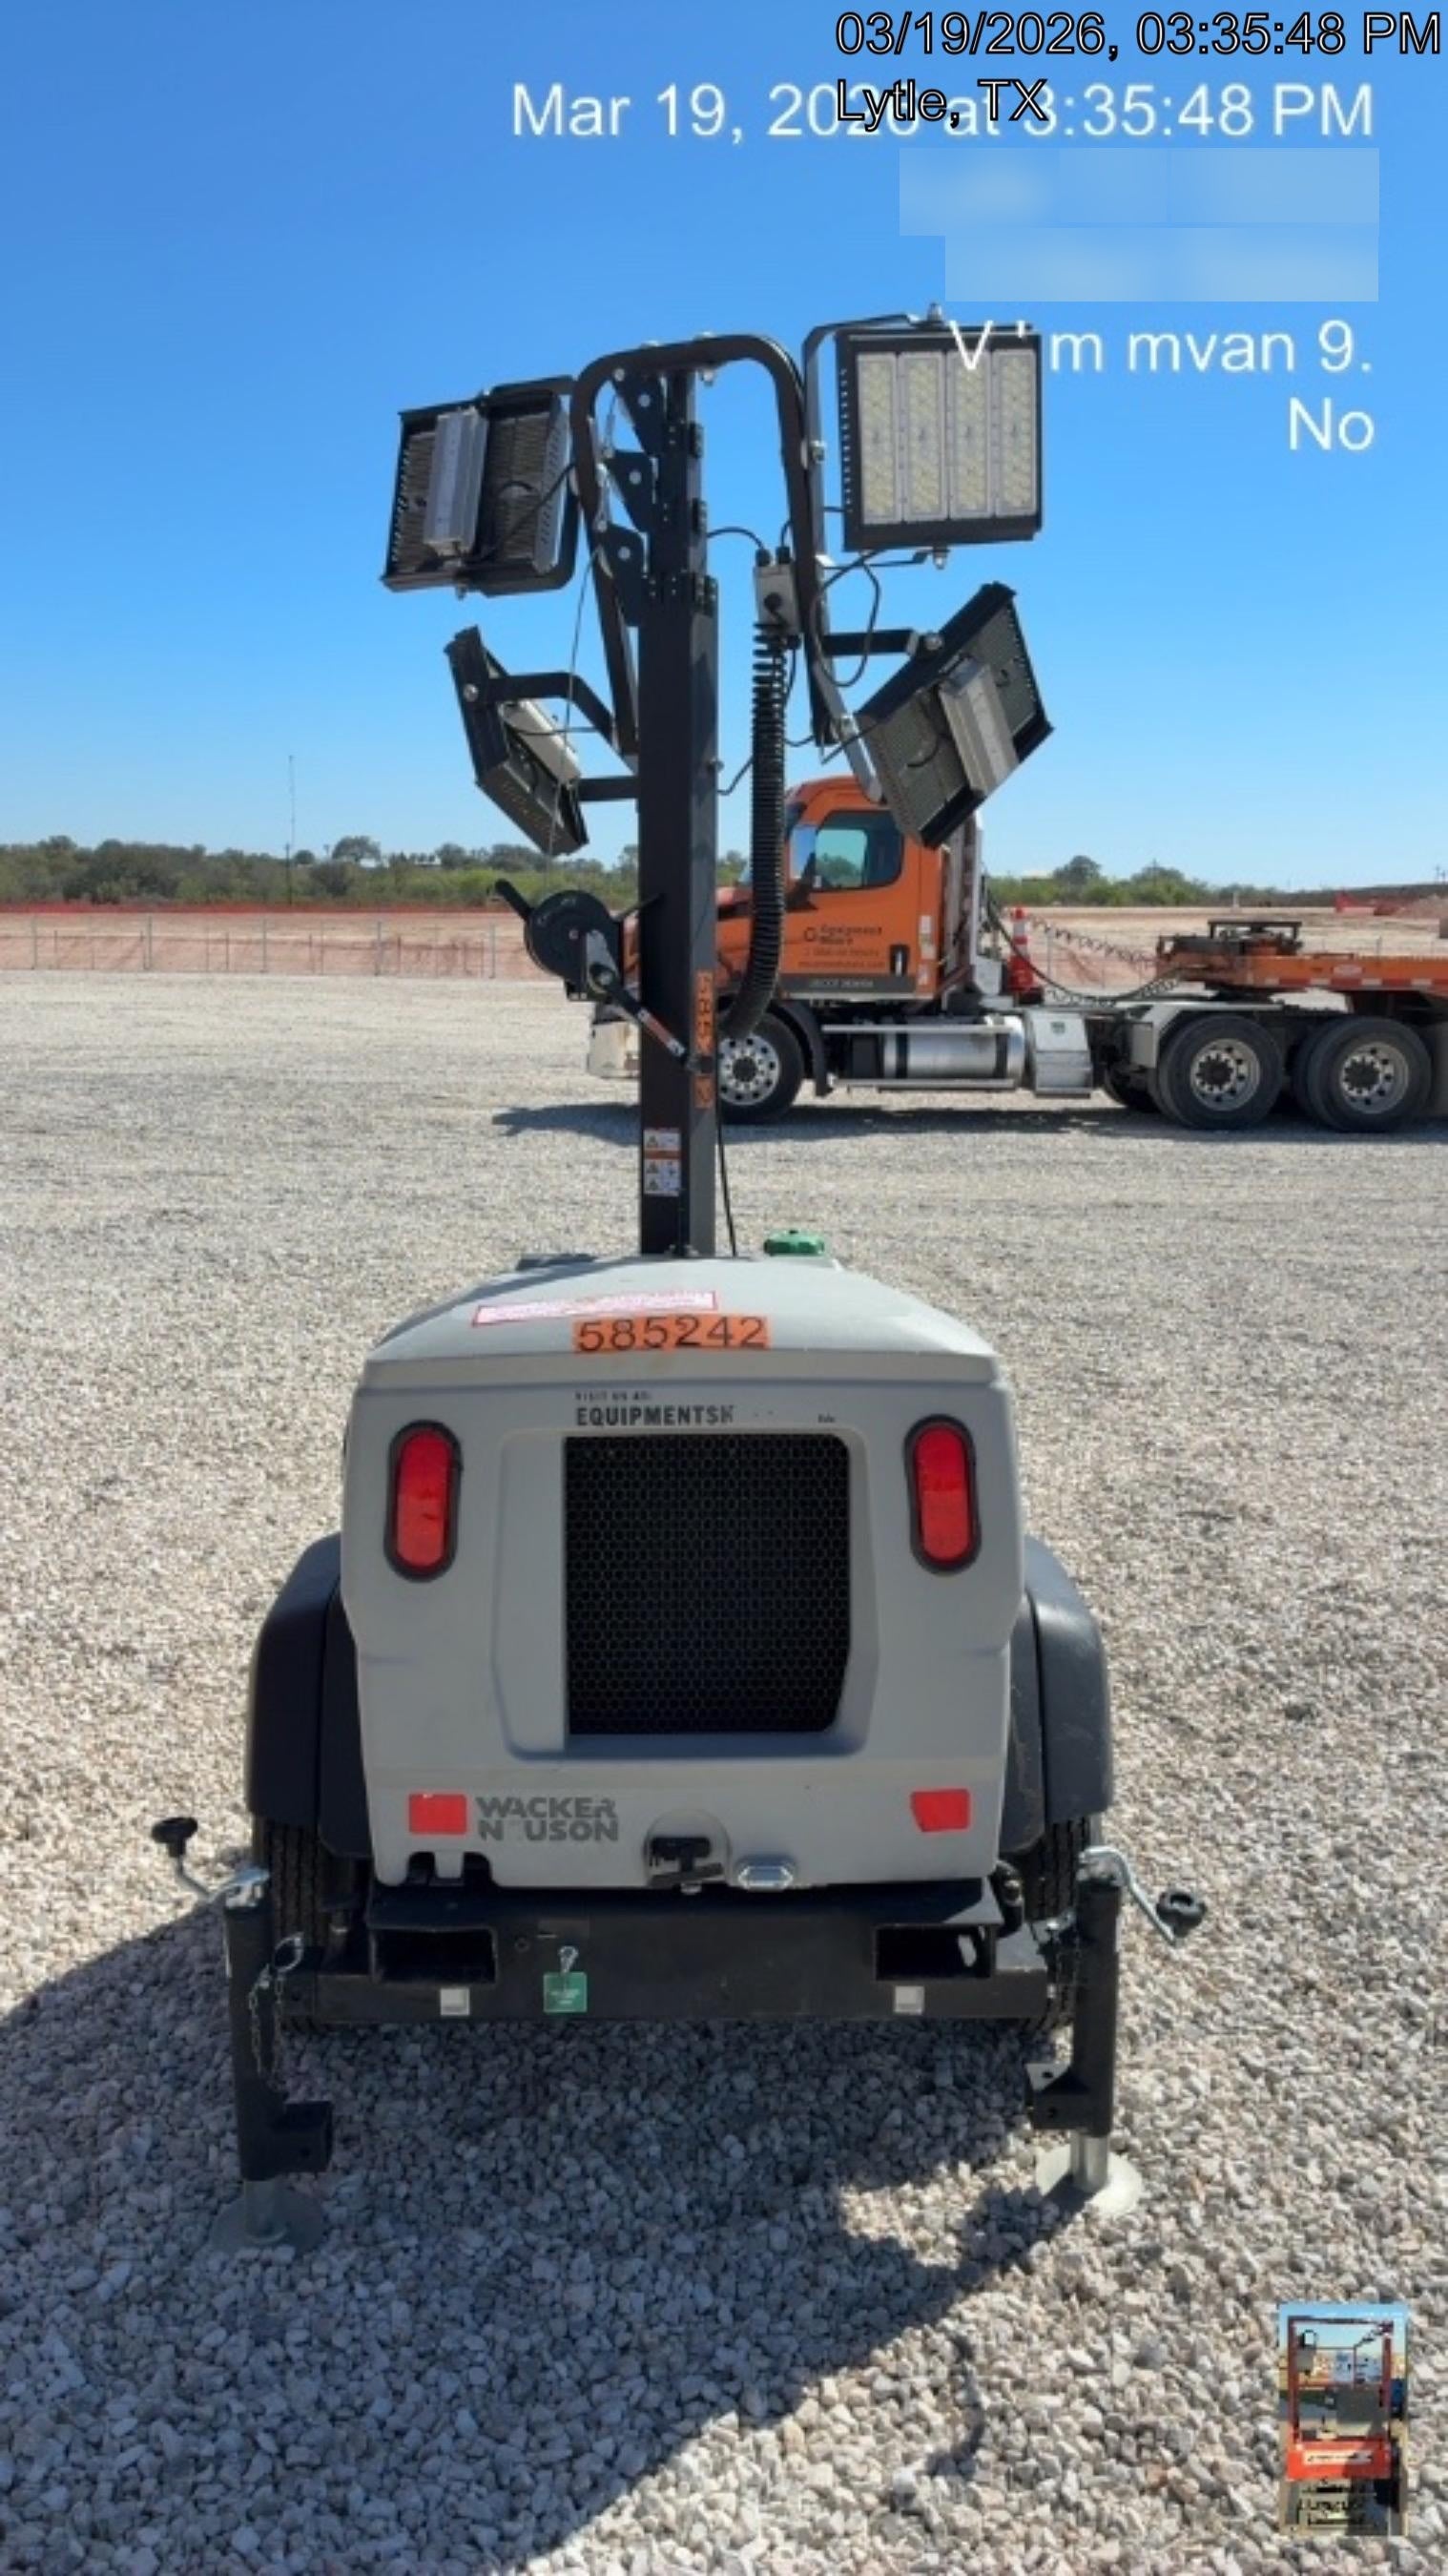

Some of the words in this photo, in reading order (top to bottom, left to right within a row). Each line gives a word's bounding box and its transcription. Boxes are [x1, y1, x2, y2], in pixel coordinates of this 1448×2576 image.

[577, 1316, 767, 1352] 585242
[476, 1797, 618, 1819] WACKER
[479, 1819, 619, 1841] NUSON
